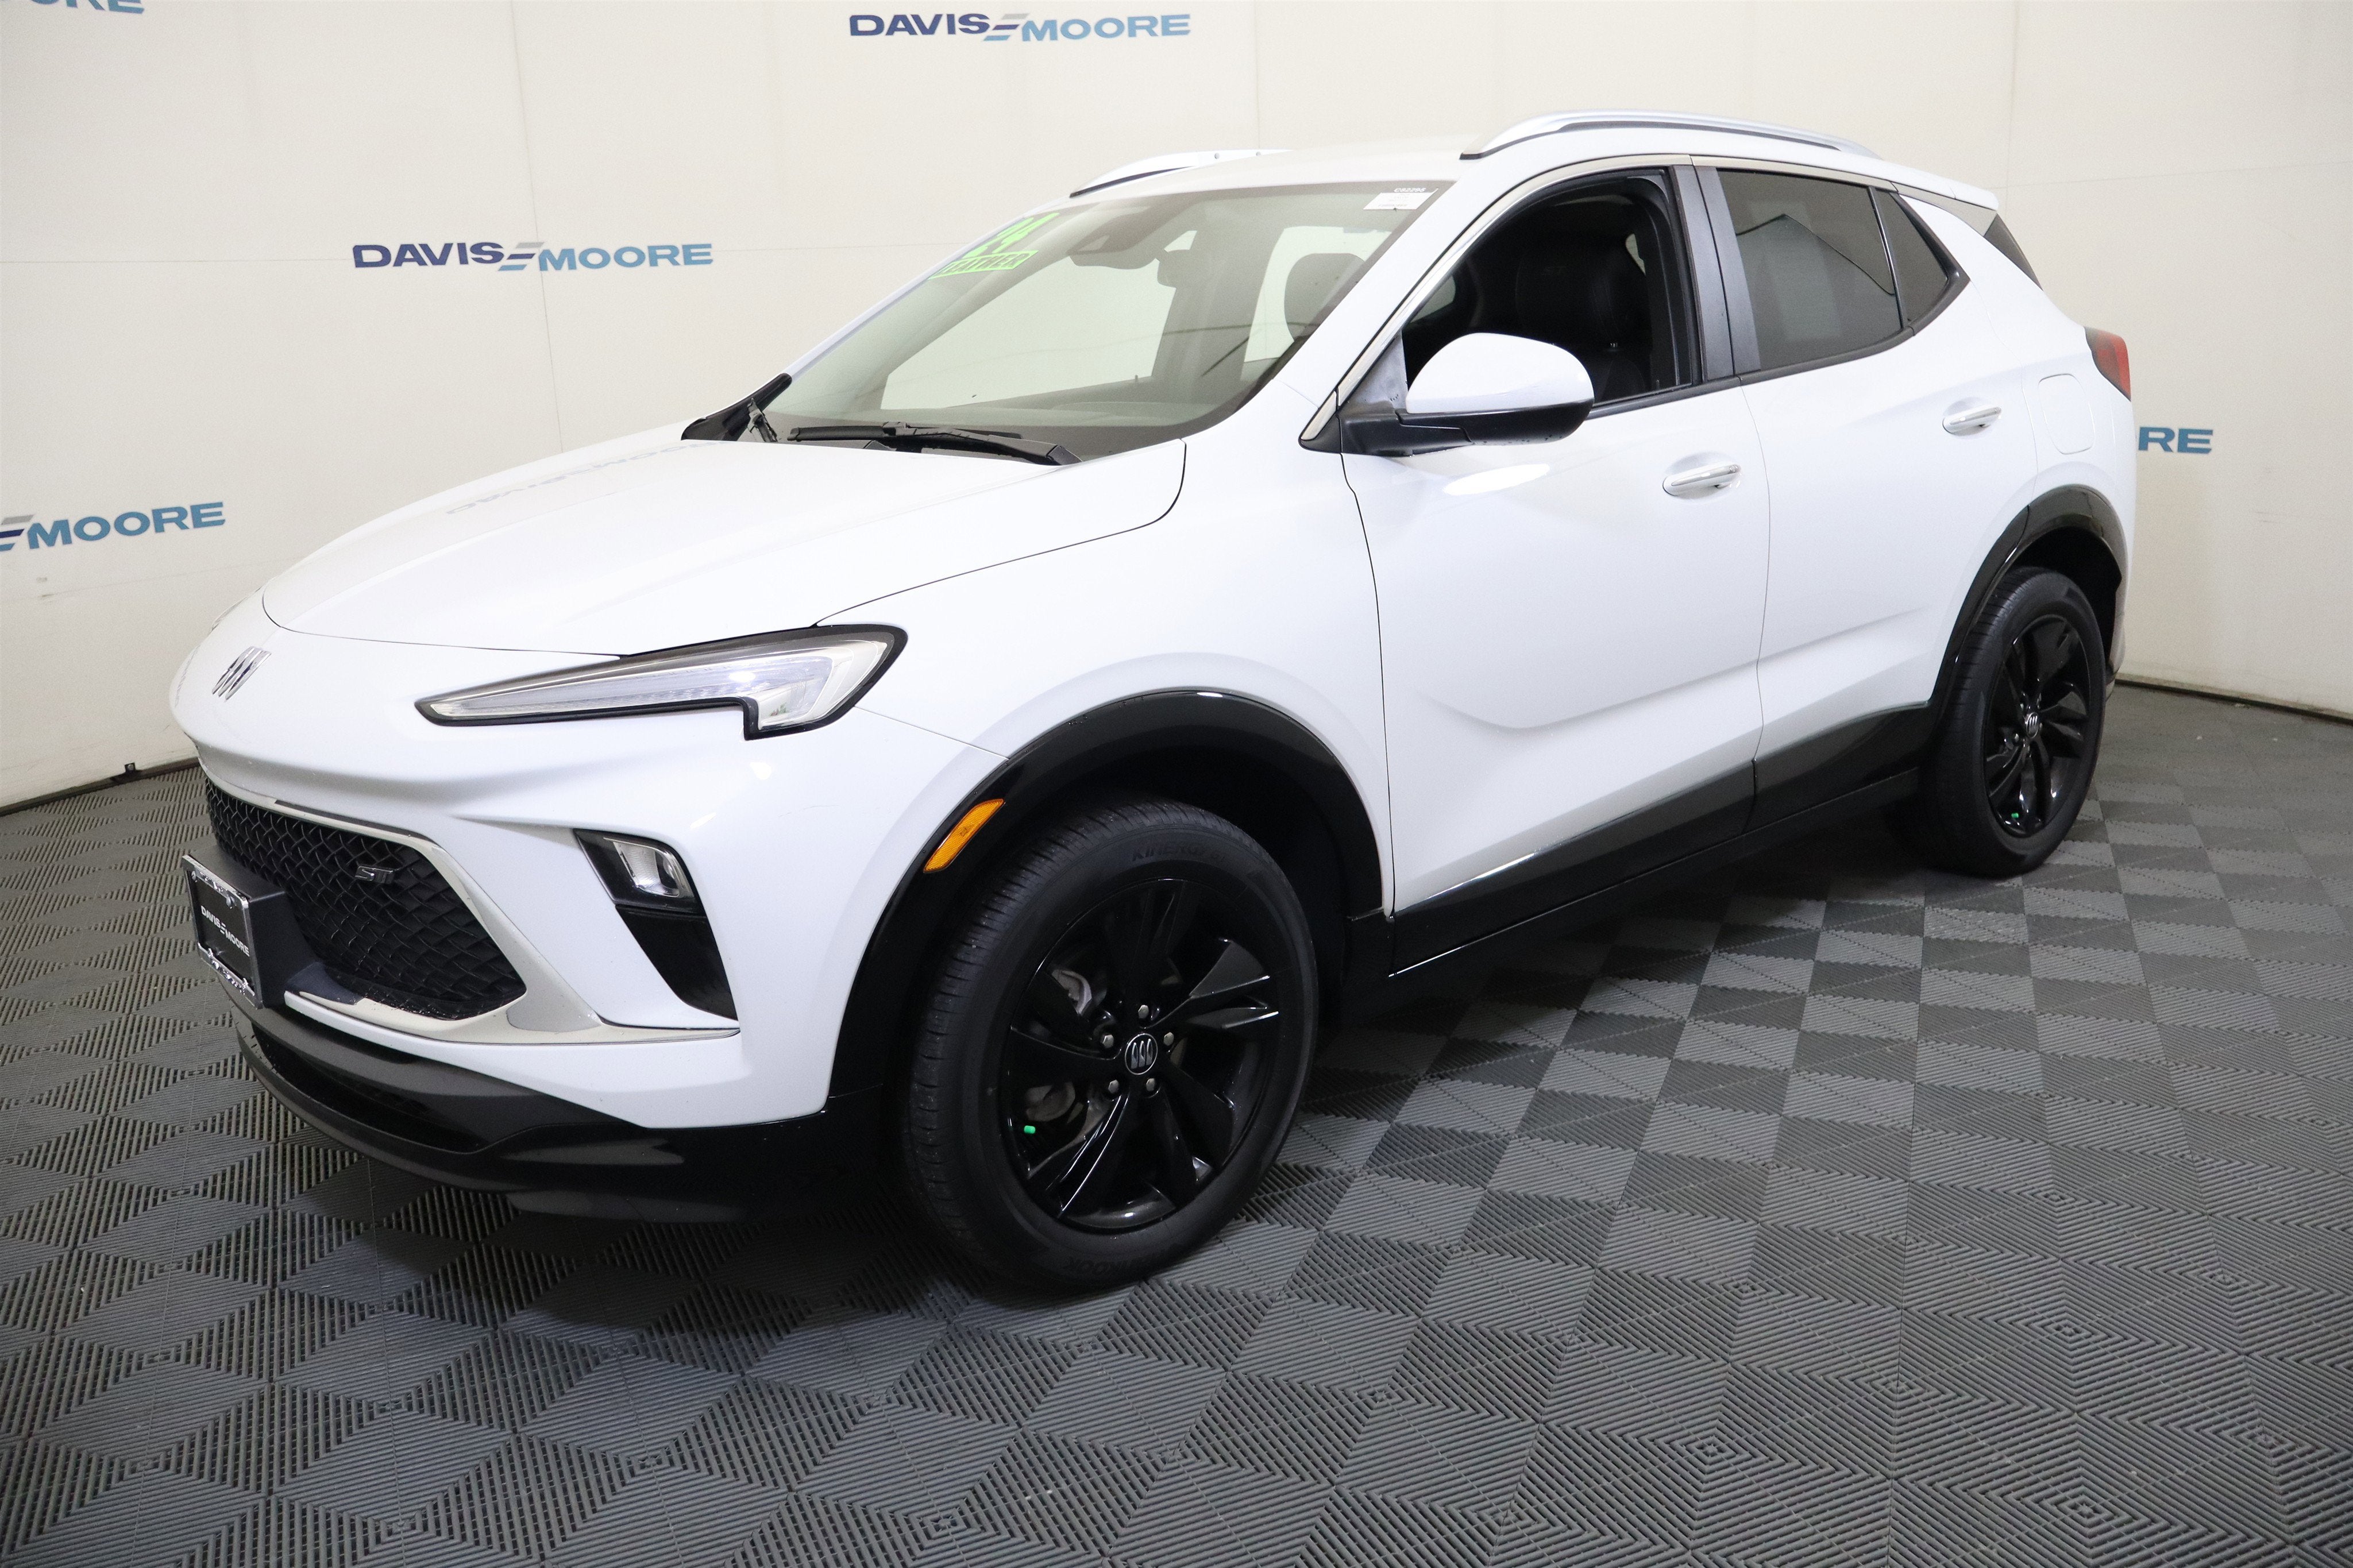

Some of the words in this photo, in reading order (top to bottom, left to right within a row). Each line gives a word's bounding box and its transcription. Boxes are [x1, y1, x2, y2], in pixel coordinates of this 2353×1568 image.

[850, 14, 990, 36] DAVIS
[1022, 14, 1191, 42] MOORE
[353, 242, 504, 268] DAVIS
[538, 243, 713, 272] MOORE
[27, 501, 226, 550] MOORE
[354, 865, 395, 884] ST
[200, 905, 221, 928] DAVIS
[225, 929, 250, 957] MOORE
